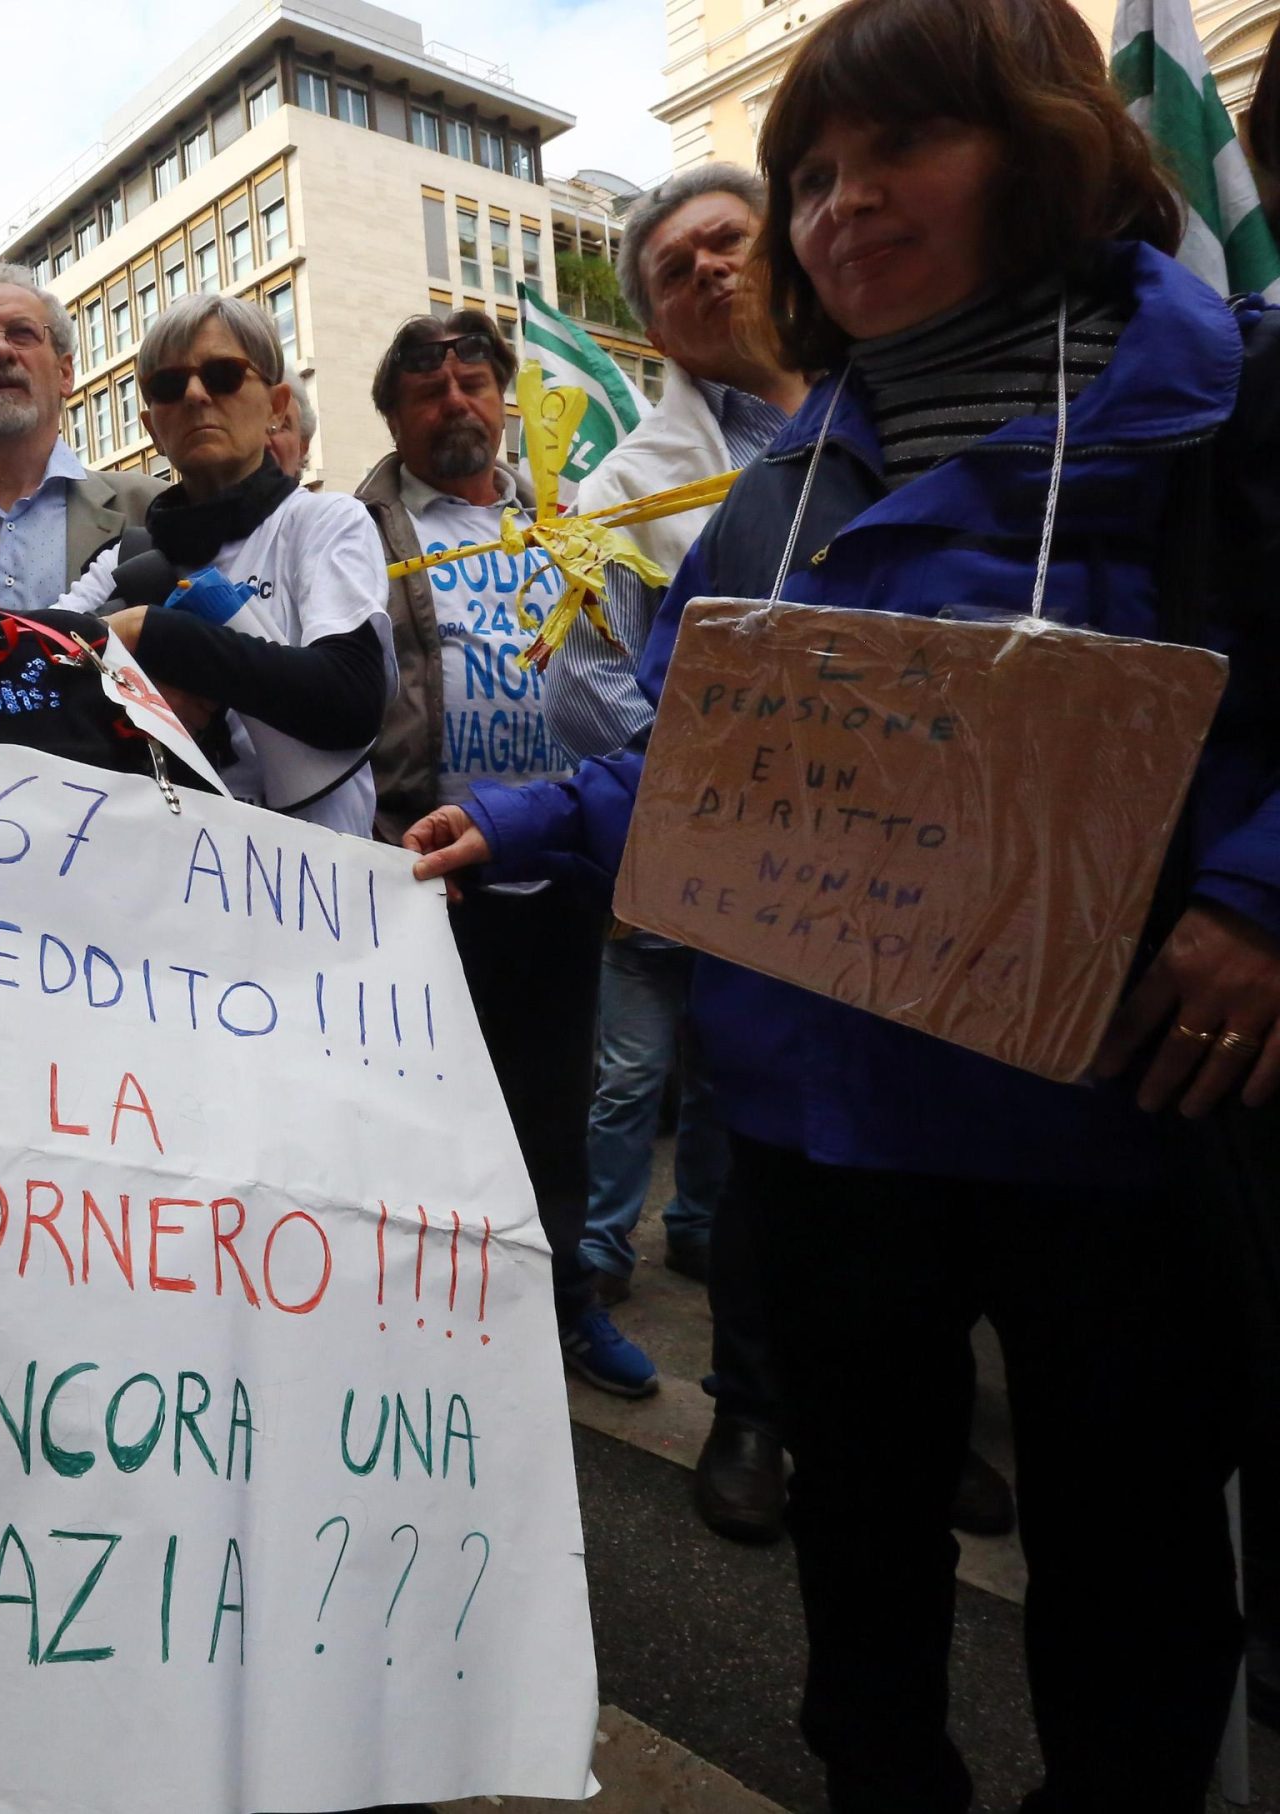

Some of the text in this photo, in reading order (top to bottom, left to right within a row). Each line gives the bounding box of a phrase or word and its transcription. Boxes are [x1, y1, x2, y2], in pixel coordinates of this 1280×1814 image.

[701, 683, 958, 743] PENSIONE
[693, 786, 947, 849] DIRITTO
[183, 827, 380, 949] ANNI
[758, 850, 849, 892] NON
[50, 1061, 164, 1155] LA
[340, 1387, 482, 1489] UNA
